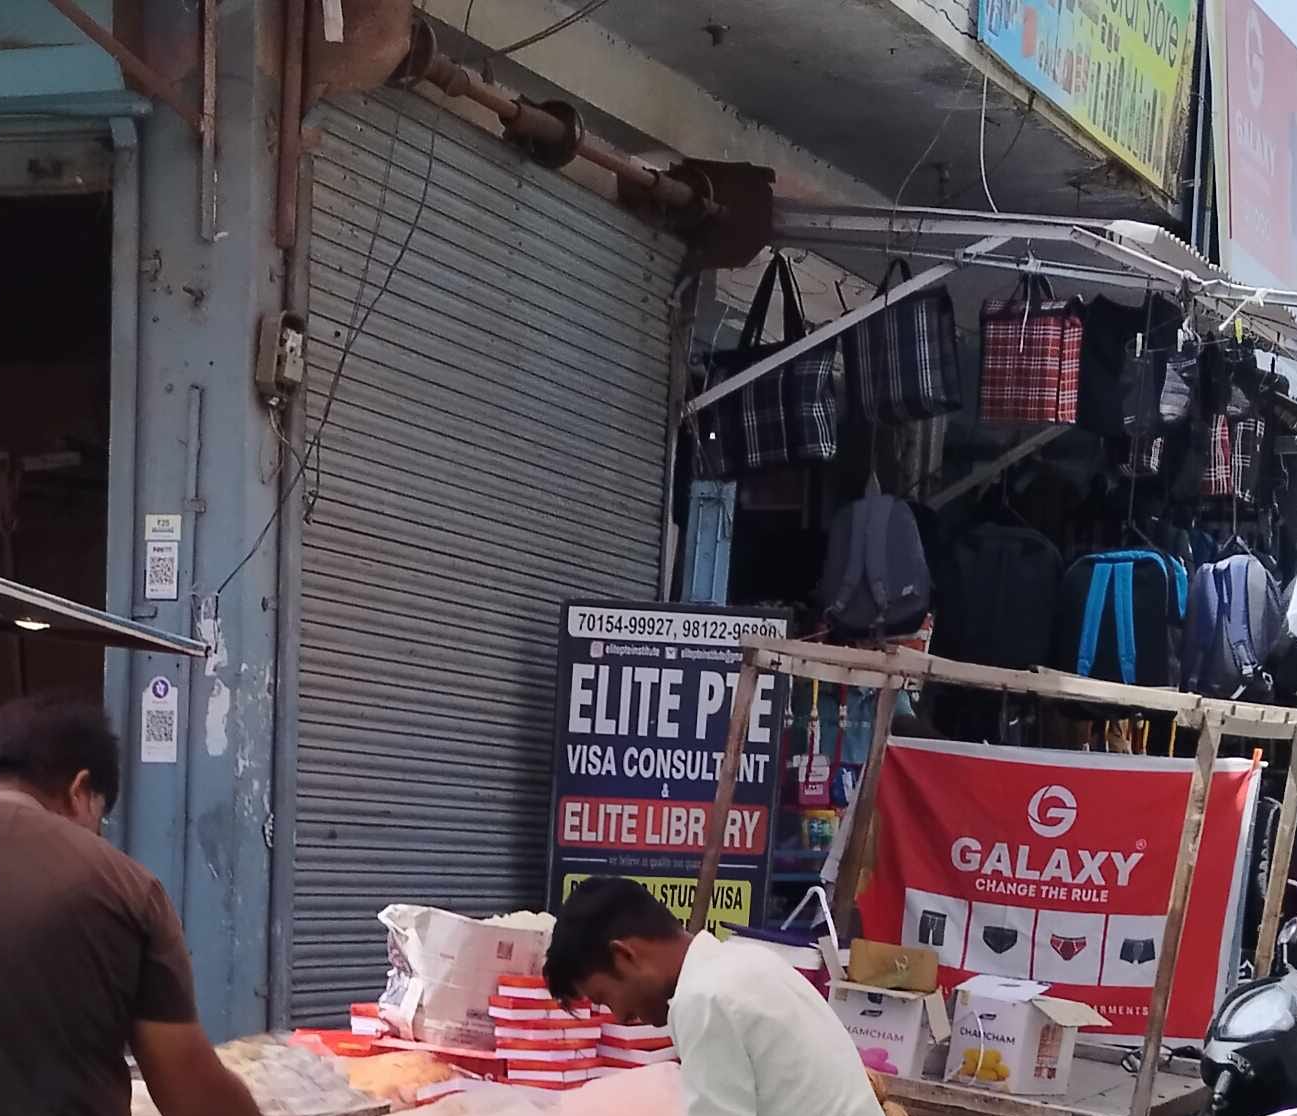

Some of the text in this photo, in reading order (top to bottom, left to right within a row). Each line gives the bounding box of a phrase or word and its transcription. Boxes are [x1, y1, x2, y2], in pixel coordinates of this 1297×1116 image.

[578, 612, 677, 640] 70154-99927,
[568, 662, 684, 739] ELITE
[566, 744, 770, 784] VISA CONSULTNT
[661, 782, 670, 798] &
[563, 802, 761, 849] ELITE LIBRRY
[950, 836, 1144, 887] GALAXY
[660, 883, 697, 908] STUD
[711, 886, 743, 910] VISA
[975, 878, 1109, 903] CHANGE THE RULE
[1091, 1004, 1150, 1016] ARMENTS
[845, 1024, 904, 1043] HAMCHAM
